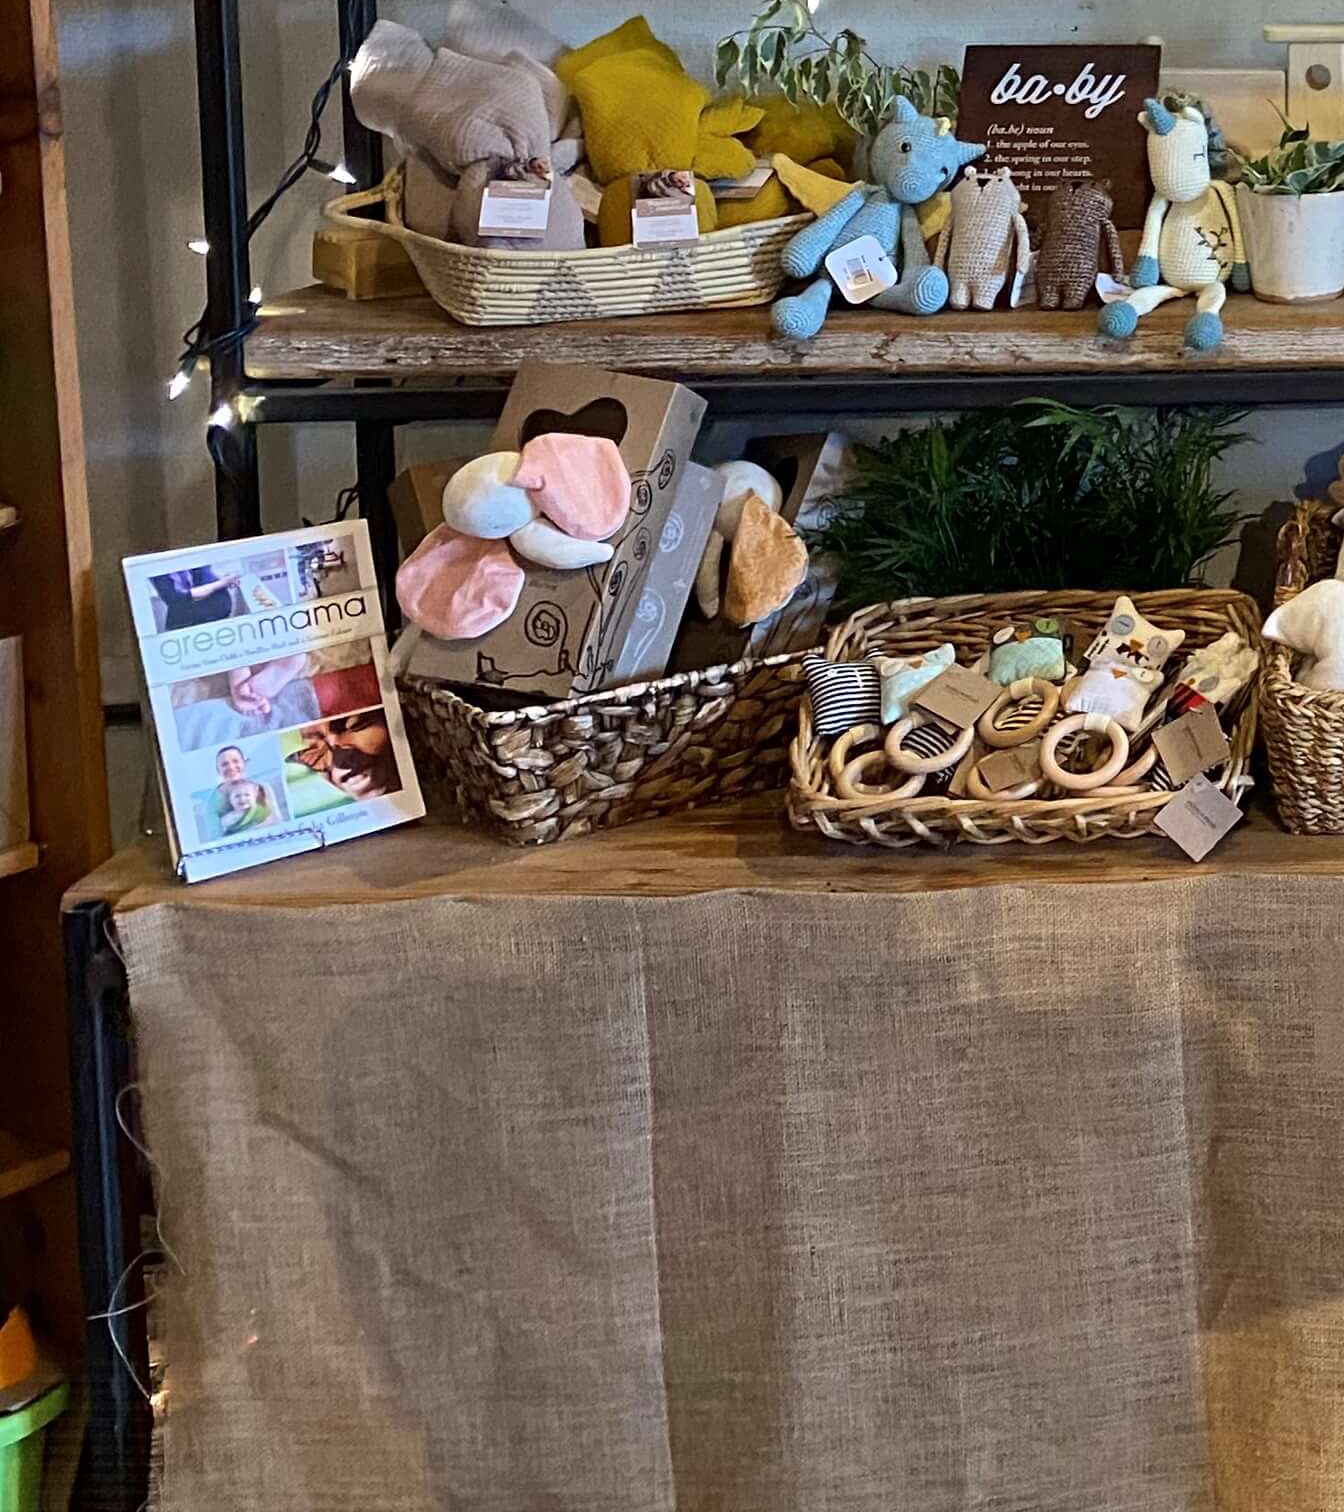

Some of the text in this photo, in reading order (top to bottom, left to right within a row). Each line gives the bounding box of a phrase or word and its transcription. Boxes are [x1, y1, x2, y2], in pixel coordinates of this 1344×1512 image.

[1026, 127, 1054, 135] noun
[996, 140, 1011, 148] the
[1012, 140, 1037, 151] apple
[1039, 139, 1051, 148] of
[159, 595, 367, 665] greenmama
